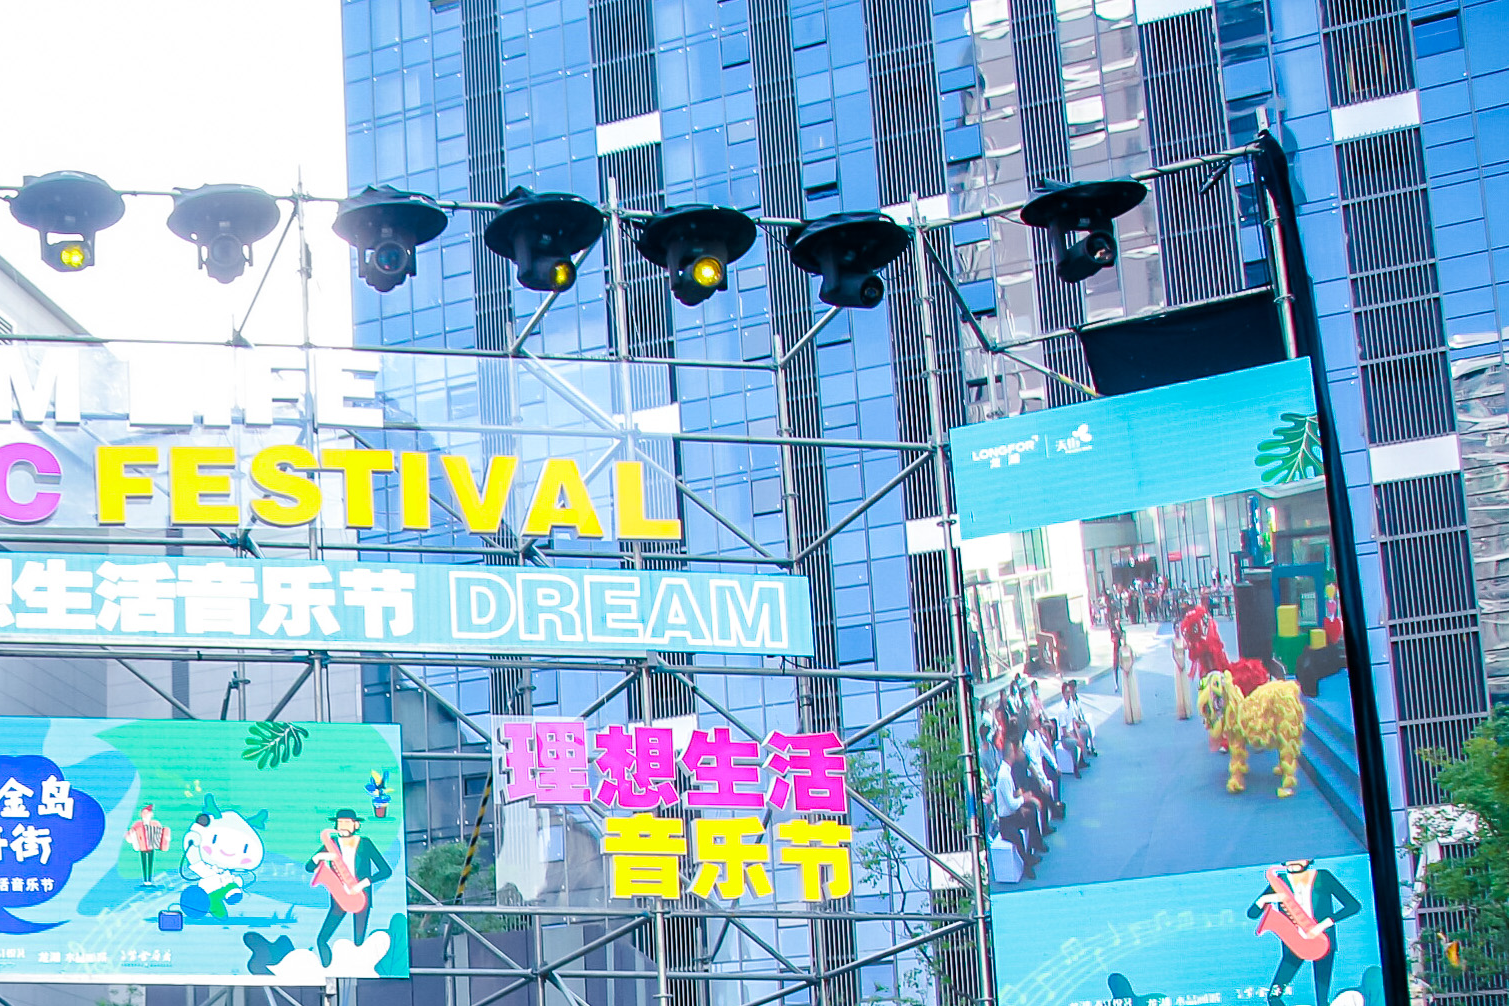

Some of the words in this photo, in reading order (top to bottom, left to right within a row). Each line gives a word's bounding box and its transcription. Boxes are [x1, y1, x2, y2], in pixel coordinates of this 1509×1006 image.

[128, 347, 384, 428] LIFE
[94, 444, 683, 541] FESTIVAL
[971, 440, 1035, 462] LONGFOR
[448, 570, 790, 649] DREAM
[499, 721, 848, 815] 理想生活
[601, 812, 853, 903] 音乐节
